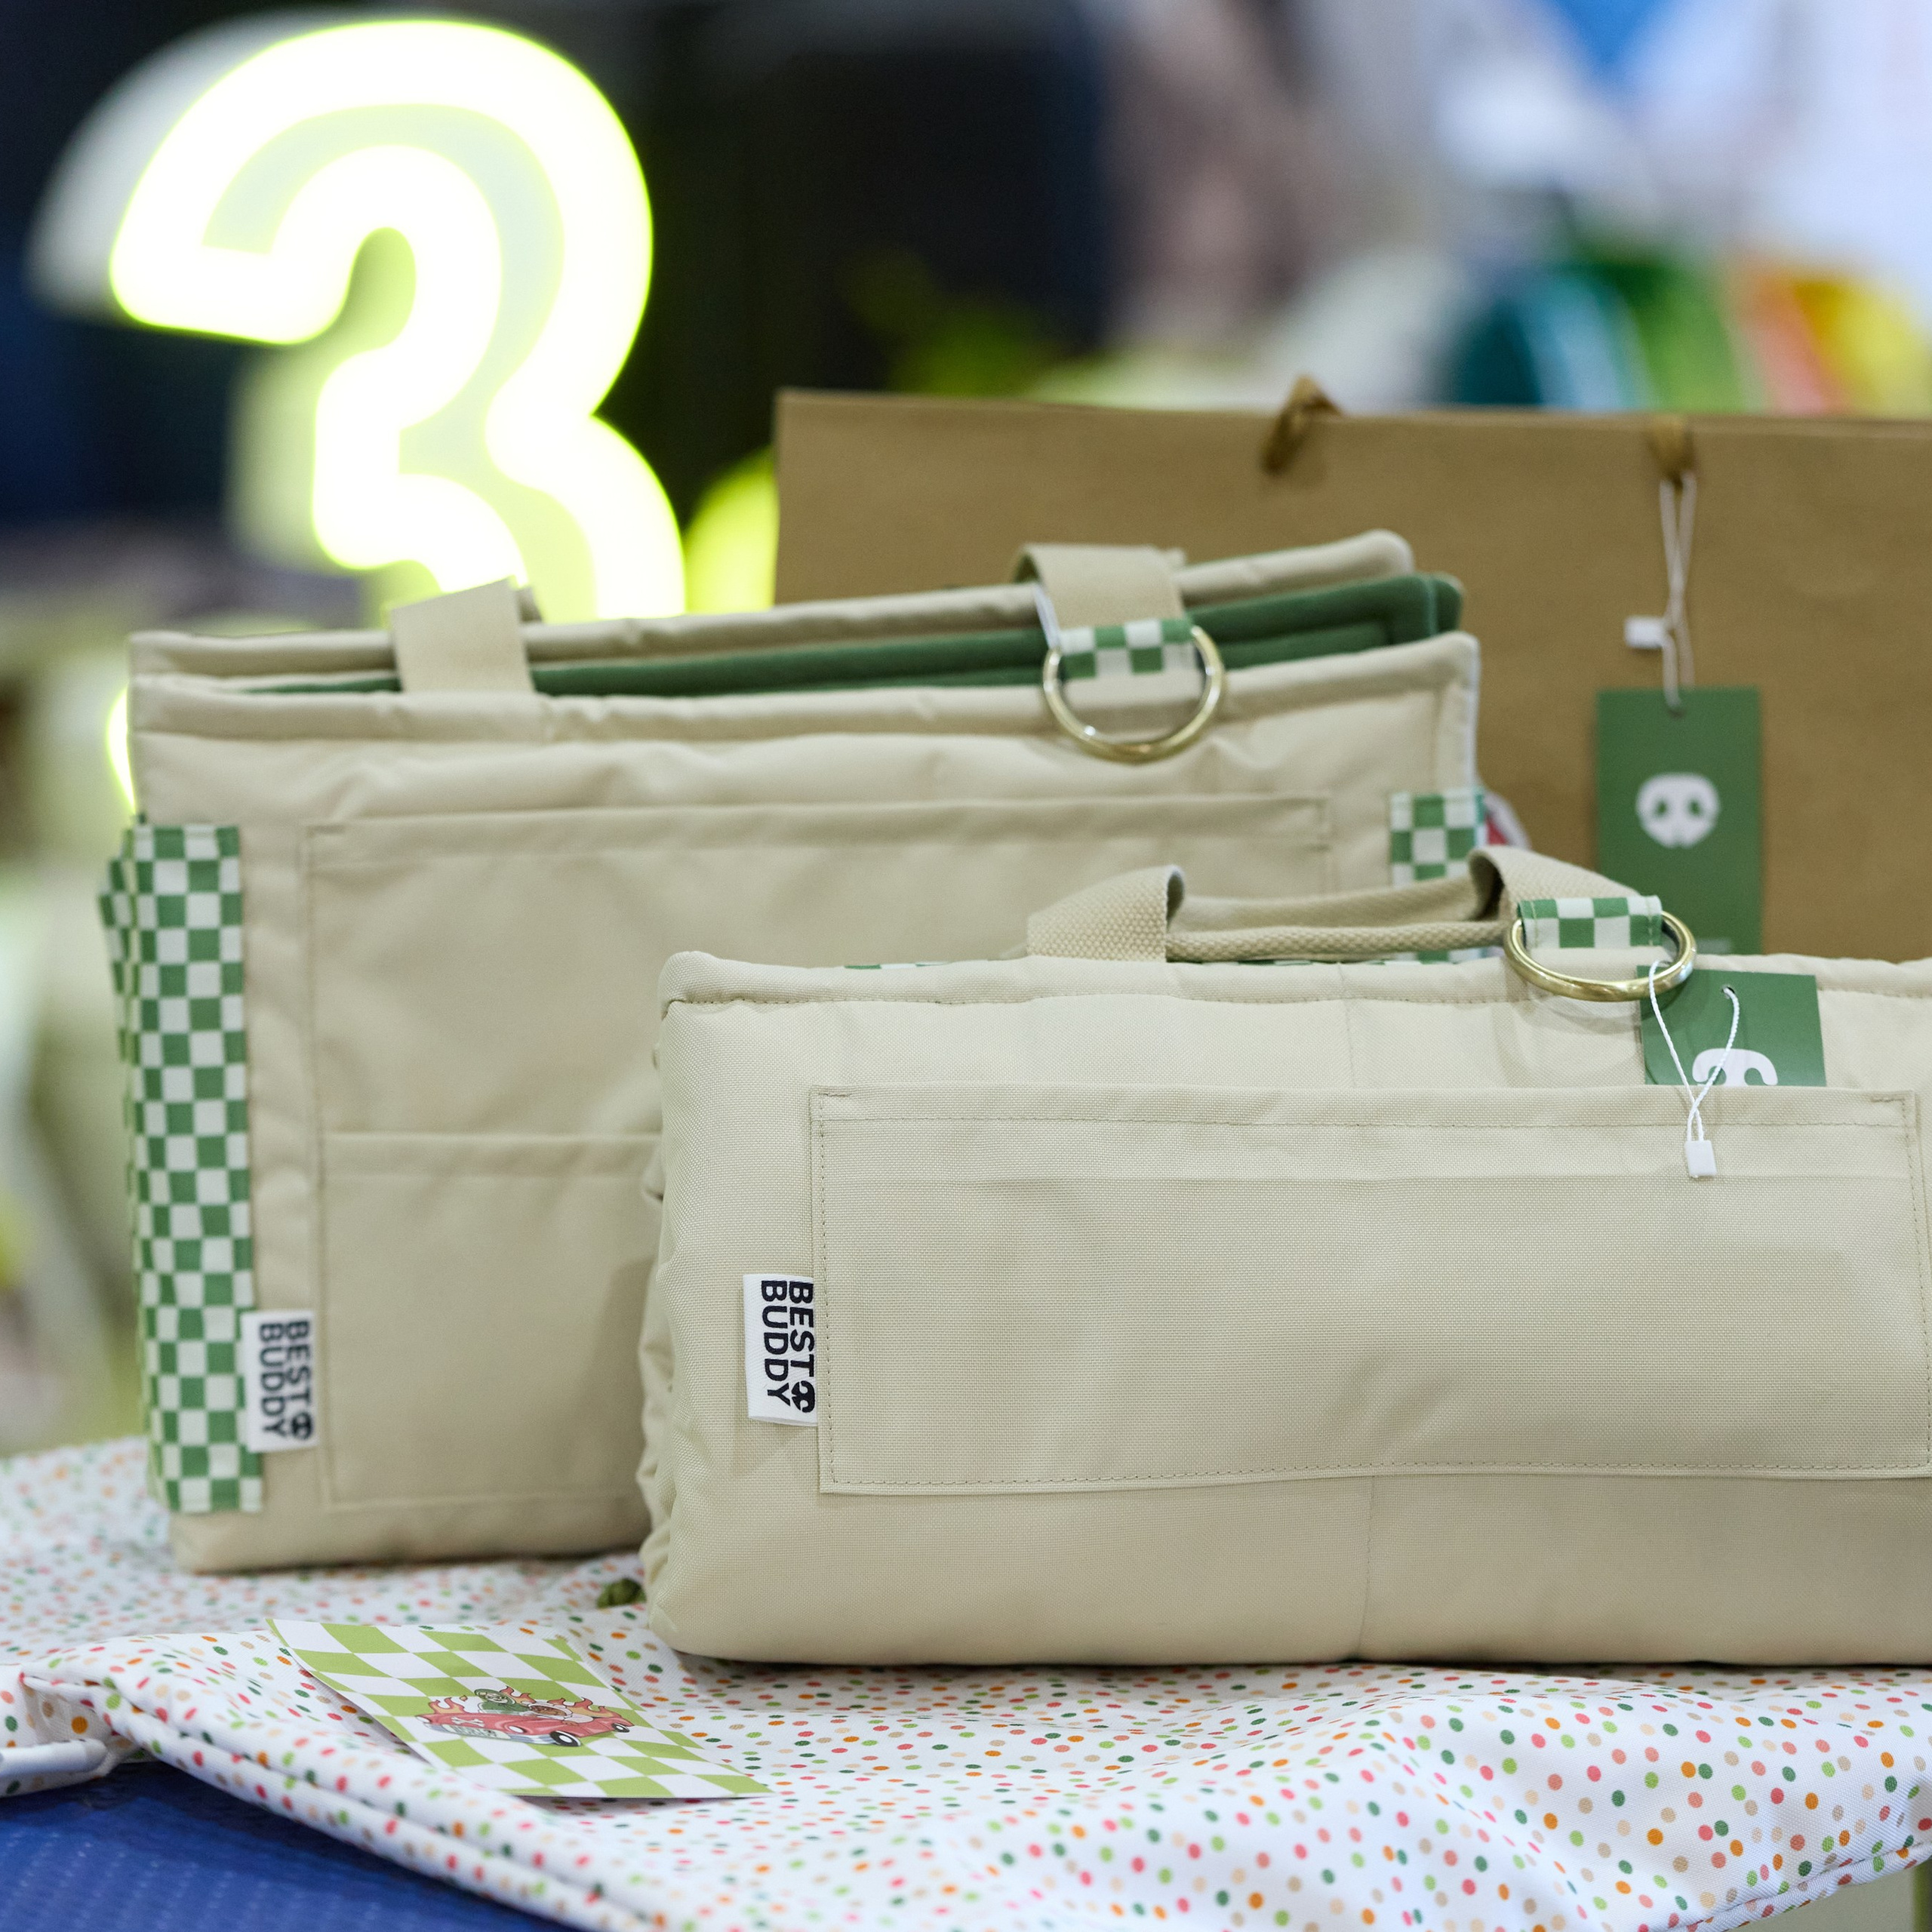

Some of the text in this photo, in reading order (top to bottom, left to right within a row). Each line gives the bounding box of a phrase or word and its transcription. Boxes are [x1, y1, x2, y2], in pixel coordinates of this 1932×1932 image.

[260, 1323, 287, 1437] BUDDY
[286, 1321, 311, 1405] BEST
[761, 1280, 791, 1407] BUDDY
[789, 1281, 814, 1377] BEST
